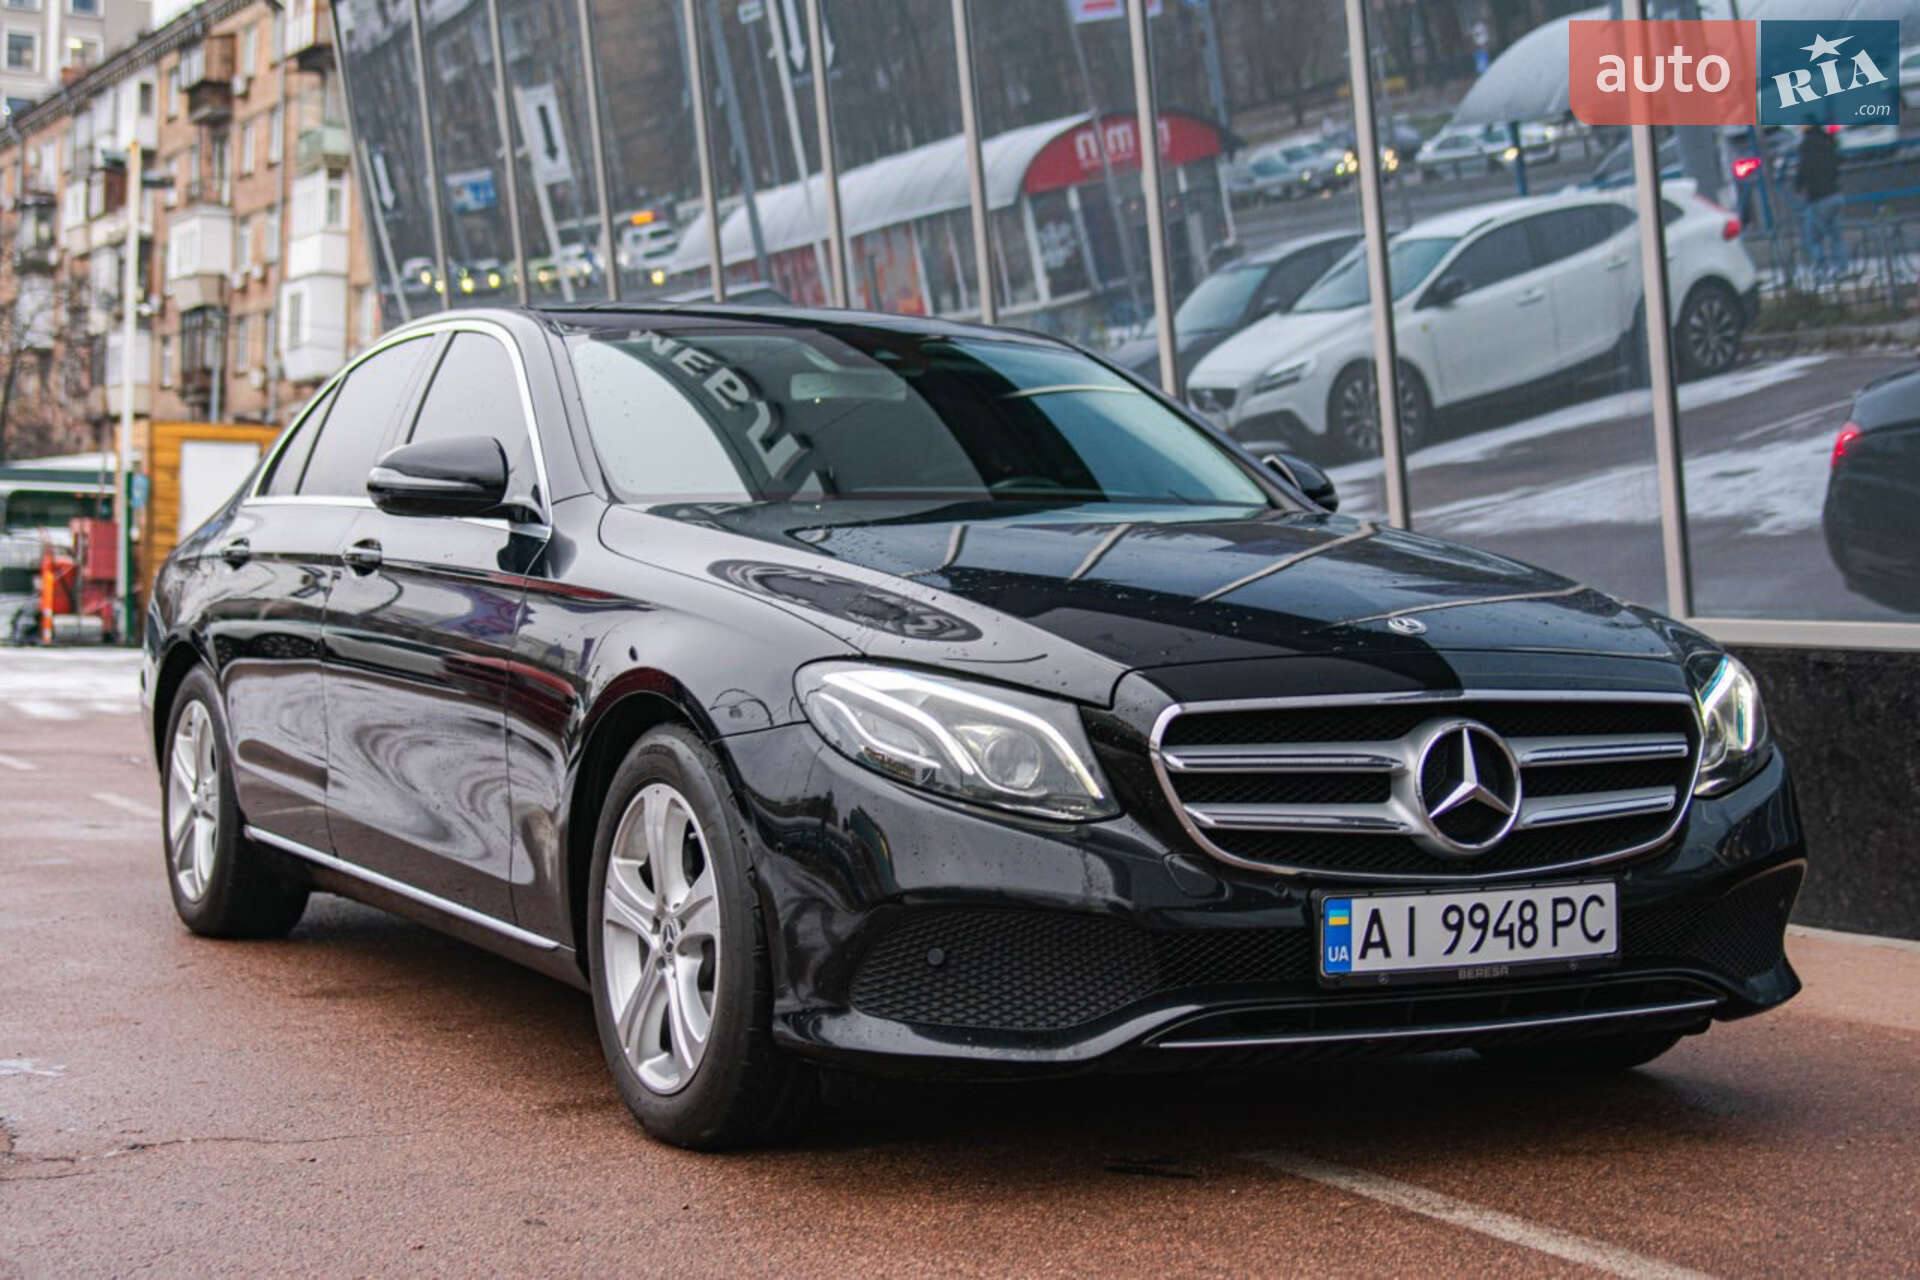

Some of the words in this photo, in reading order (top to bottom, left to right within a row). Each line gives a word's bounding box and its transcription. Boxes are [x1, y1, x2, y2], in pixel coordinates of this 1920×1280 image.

[1441, 899, 1538, 956] 9948
[1552, 894, 1606, 948] PC
[1328, 946, 1349, 962] UA
